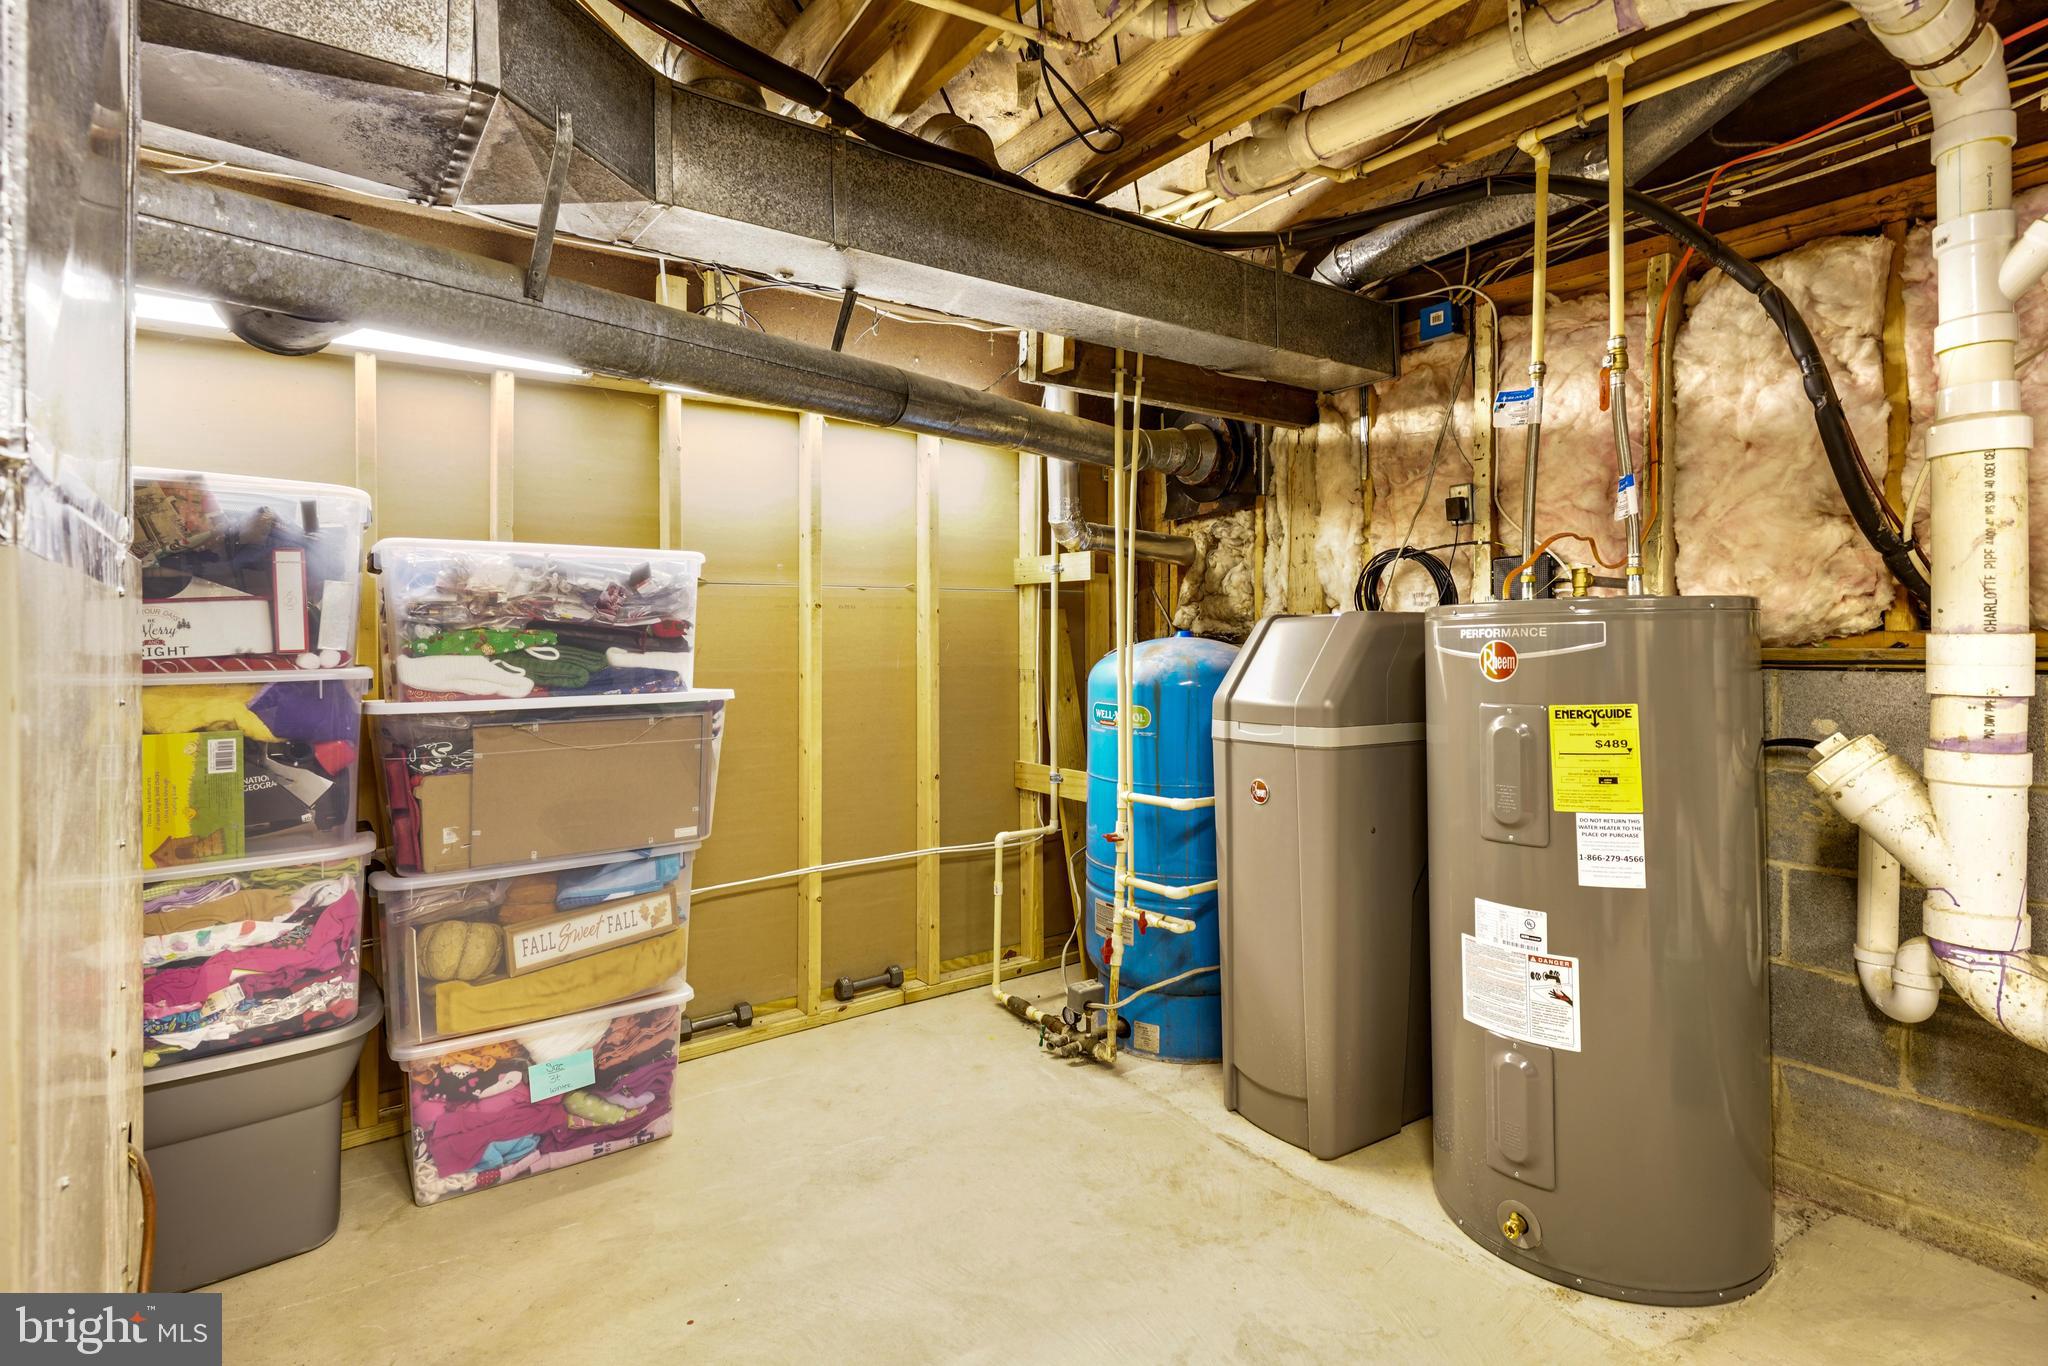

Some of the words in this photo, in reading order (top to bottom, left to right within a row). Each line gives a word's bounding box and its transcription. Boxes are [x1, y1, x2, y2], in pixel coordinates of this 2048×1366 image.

[1983, 549, 1997, 569] PIPE
[1983, 575, 1998, 632] CHARLOTTE
[1460, 627, 1548, 639] PERFORMANCE
[142, 645, 190, 657] IGHT
[1483, 642, 1516, 675] Rheem
[1554, 708, 1632, 724] ENERGYGUIDE
[1595, 739, 1628, 748] $489
[244, 774, 270, 785] NATIO
[1579, 854, 1644, 863] 1-866-279-4566
[522, 931, 557, 958] FALL
[558, 914, 605, 952] Sweet
[607, 909, 639, 934] FALL
[1537, 957, 1570, 967] DANGER
